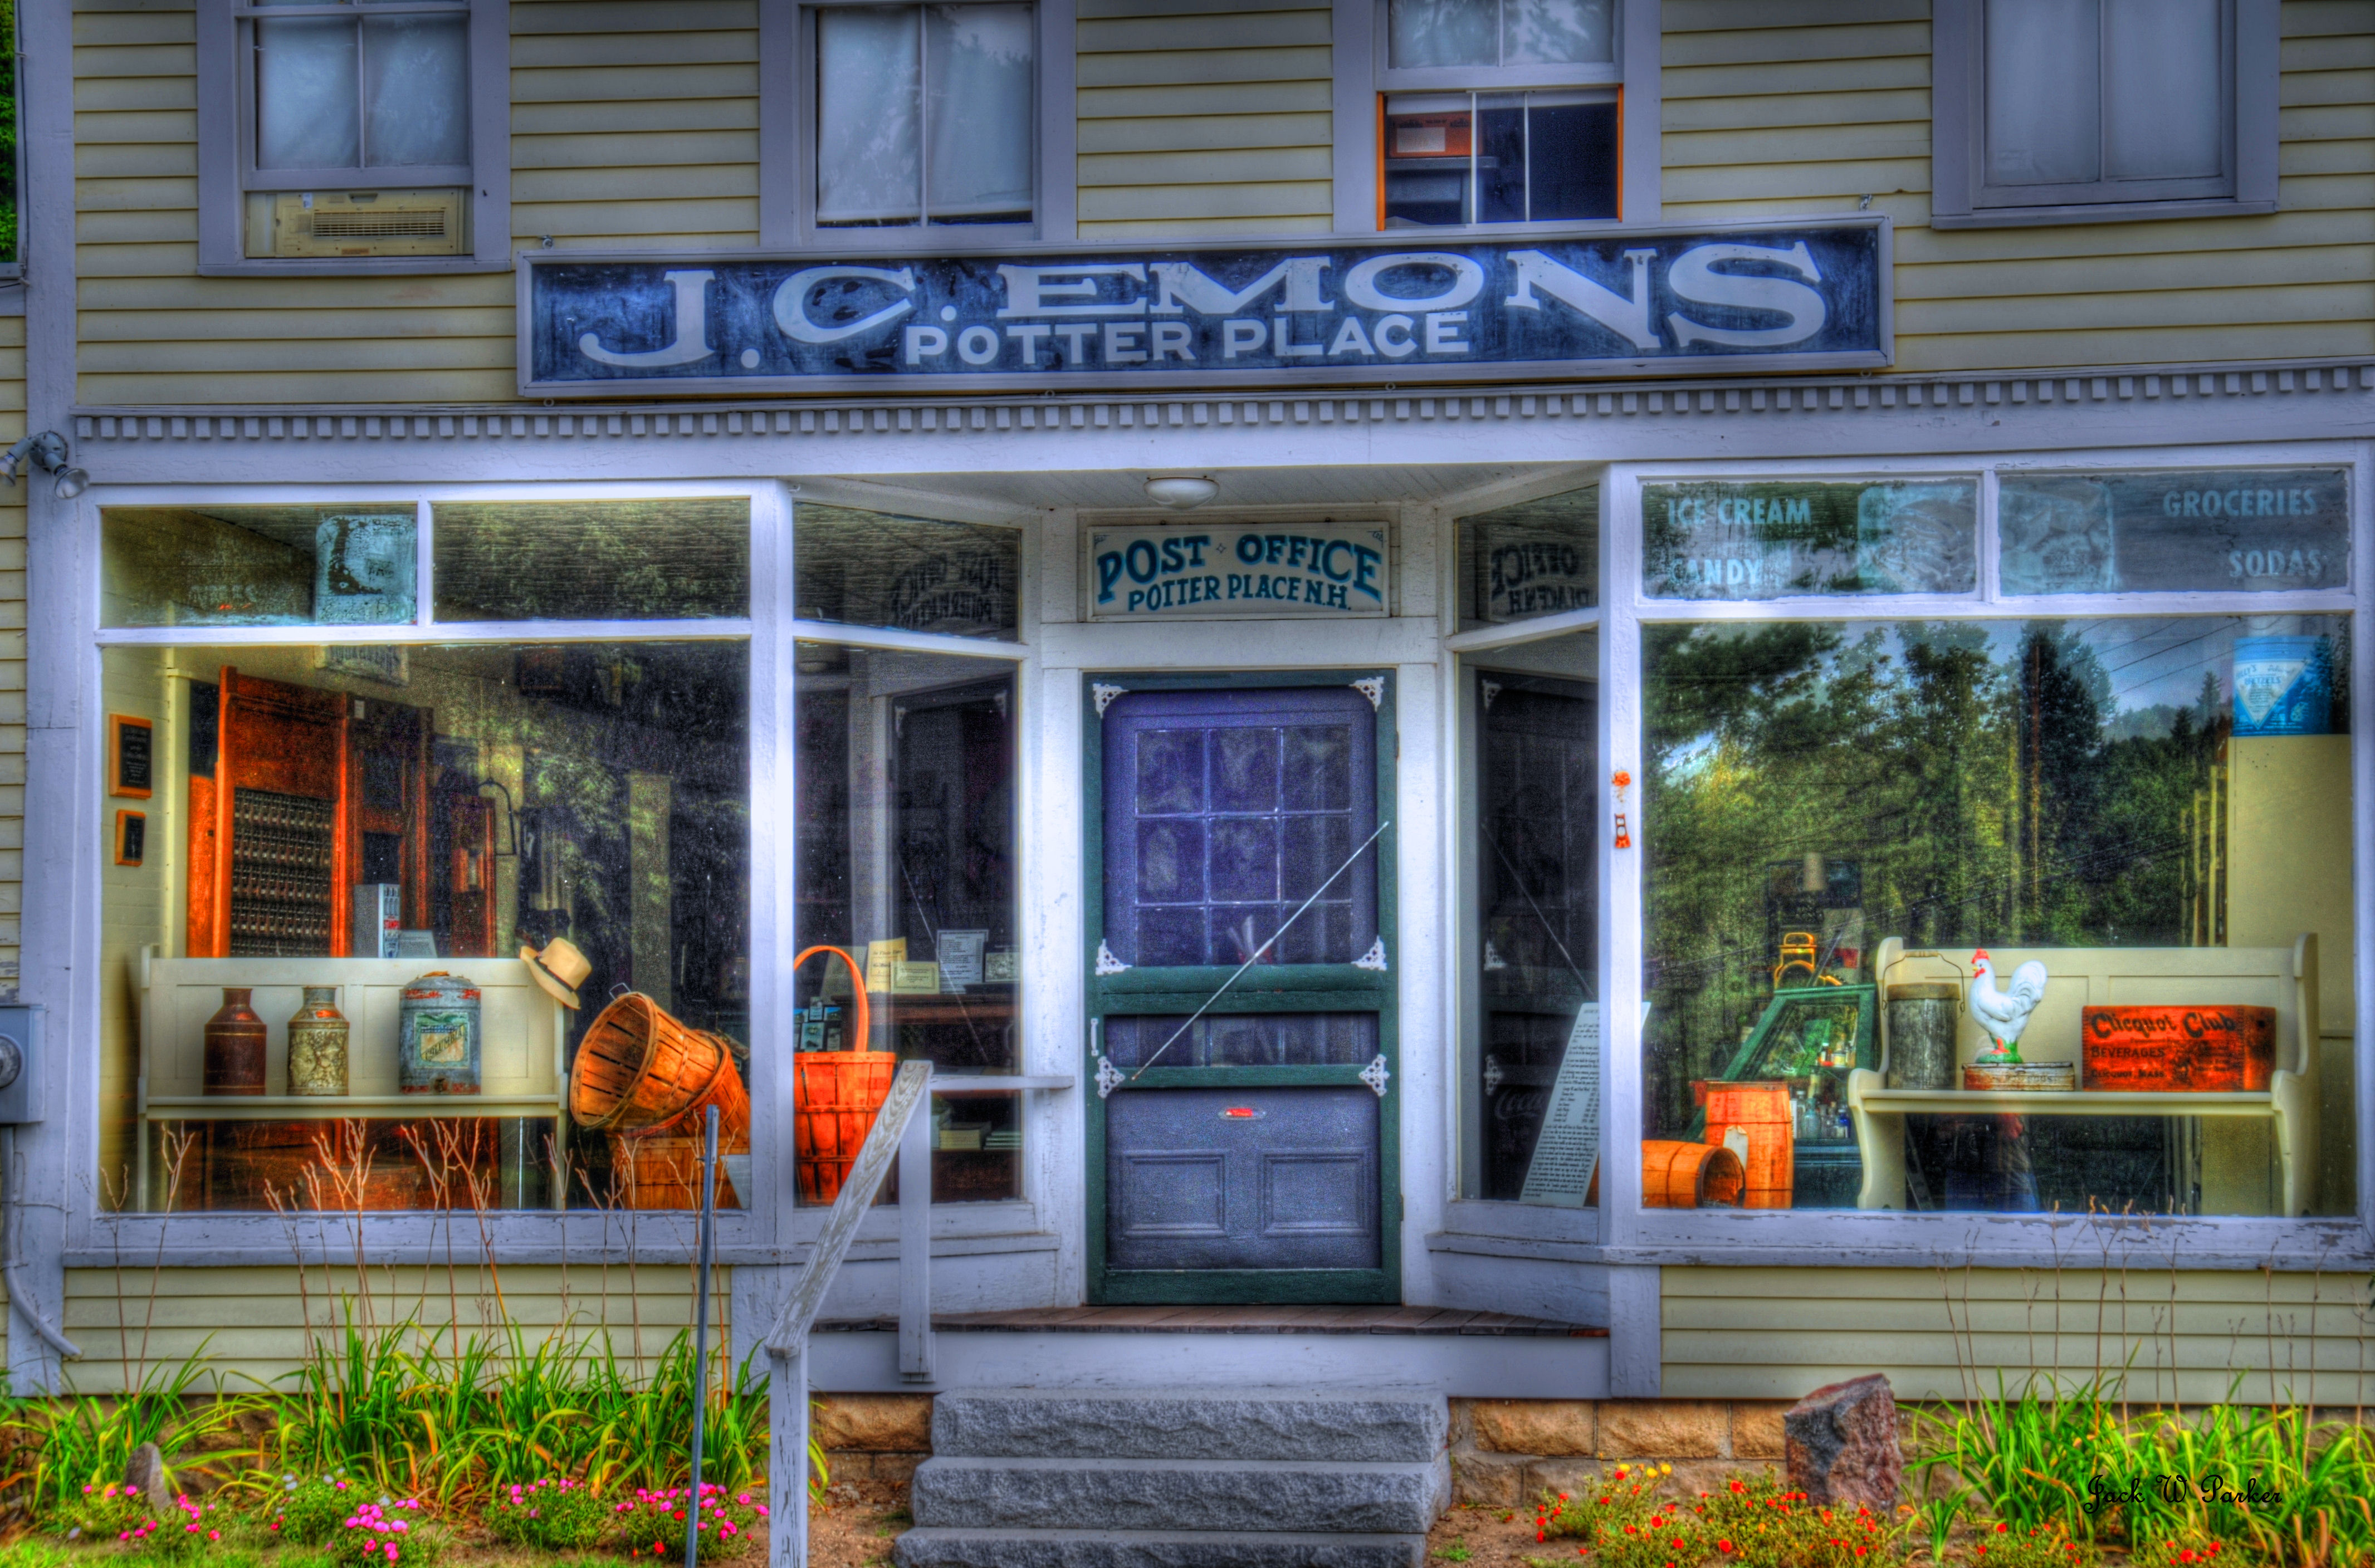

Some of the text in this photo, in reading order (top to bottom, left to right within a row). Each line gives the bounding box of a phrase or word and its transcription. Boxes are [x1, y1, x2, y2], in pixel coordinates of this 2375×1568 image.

[996, 240, 1827, 350] EMONS
[905, 311, 1470, 365] POTTER PLACE
[1668, 498, 1811, 525] ICE CREAM
[2162, 488, 2318, 518] GROCERIES
[1097, 533, 1382, 604] POST OFFICE
[1670, 558, 1764, 586] CANDY
[2229, 548, 2322, 577] SODAS
[1128, 573, 1352, 612] POTTER PLACE N.H.
[2090, 1011, 2236, 1038] Clicquot Club
[2090, 1045, 2166, 1058] BEVERAGES
